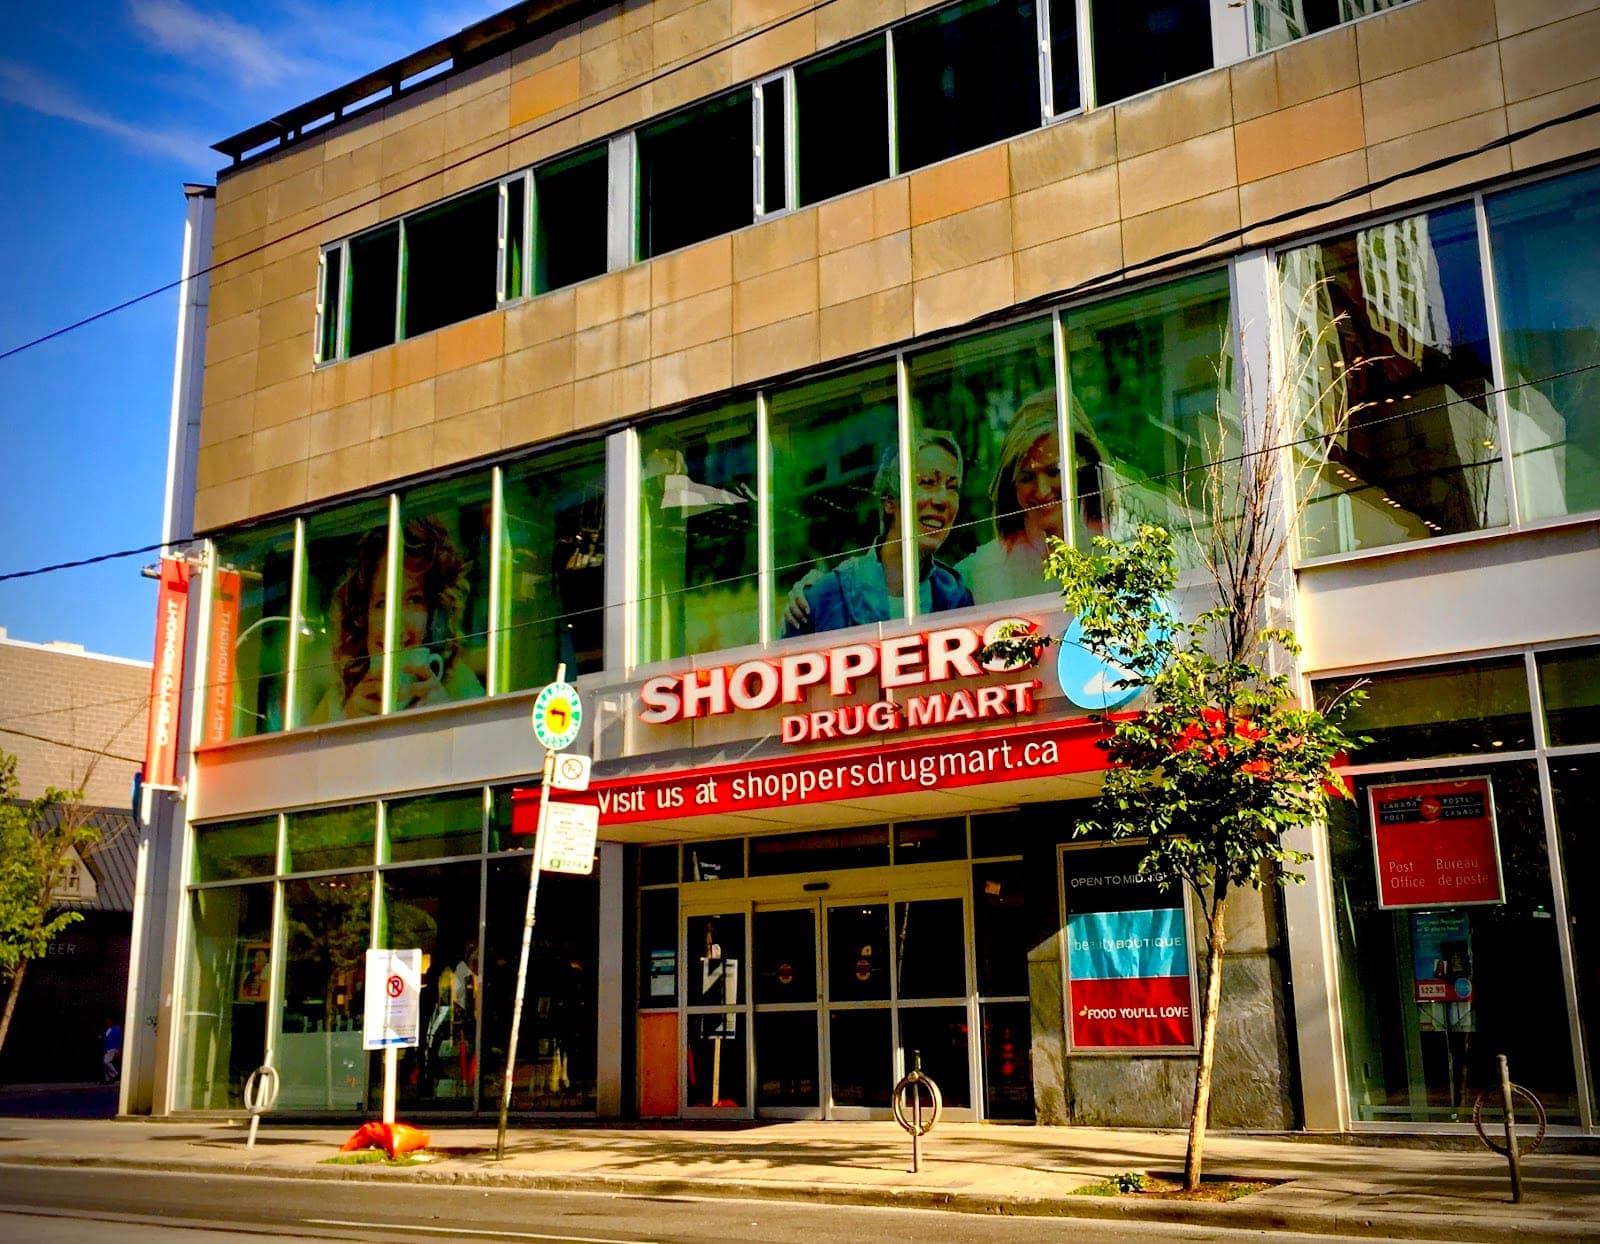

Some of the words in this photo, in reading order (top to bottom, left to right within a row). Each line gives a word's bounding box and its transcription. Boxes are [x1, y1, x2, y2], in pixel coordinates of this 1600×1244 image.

[161, 599, 179, 675] MIDNIGHT
[639, 617, 1042, 724] SHOPPERS
[160, 677, 172, 699] TO
[782, 700, 899, 744] DRUG
[908, 680, 1039, 728] MART
[157, 702, 171, 746] OPEN
[597, 787, 646, 815] Visit
[656, 785, 685, 809] us
[696, 778, 718, 804] at
[732, 740, 1059, 802] shoppersdrugmart.ca
[1382, 801, 1418, 811] CANADA
[1444, 807, 1481, 817] CANADA
[1383, 814, 1405, 822] POST
[1389, 860, 1415, 874] Post
[1435, 858, 1479, 871] Bureau
[1071, 876, 1103, 890] OPEN
[1104, 875, 1122, 887] TO
[1390, 875, 1426, 890] Office
[1437, 874, 1453, 887] de
[1456, 872, 1490, 889] poste
[1087, 1008, 1117, 1020] FOOD
[1119, 1007, 1157, 1019] YOU'LL
[1160, 1006, 1190, 1018] LOVE
